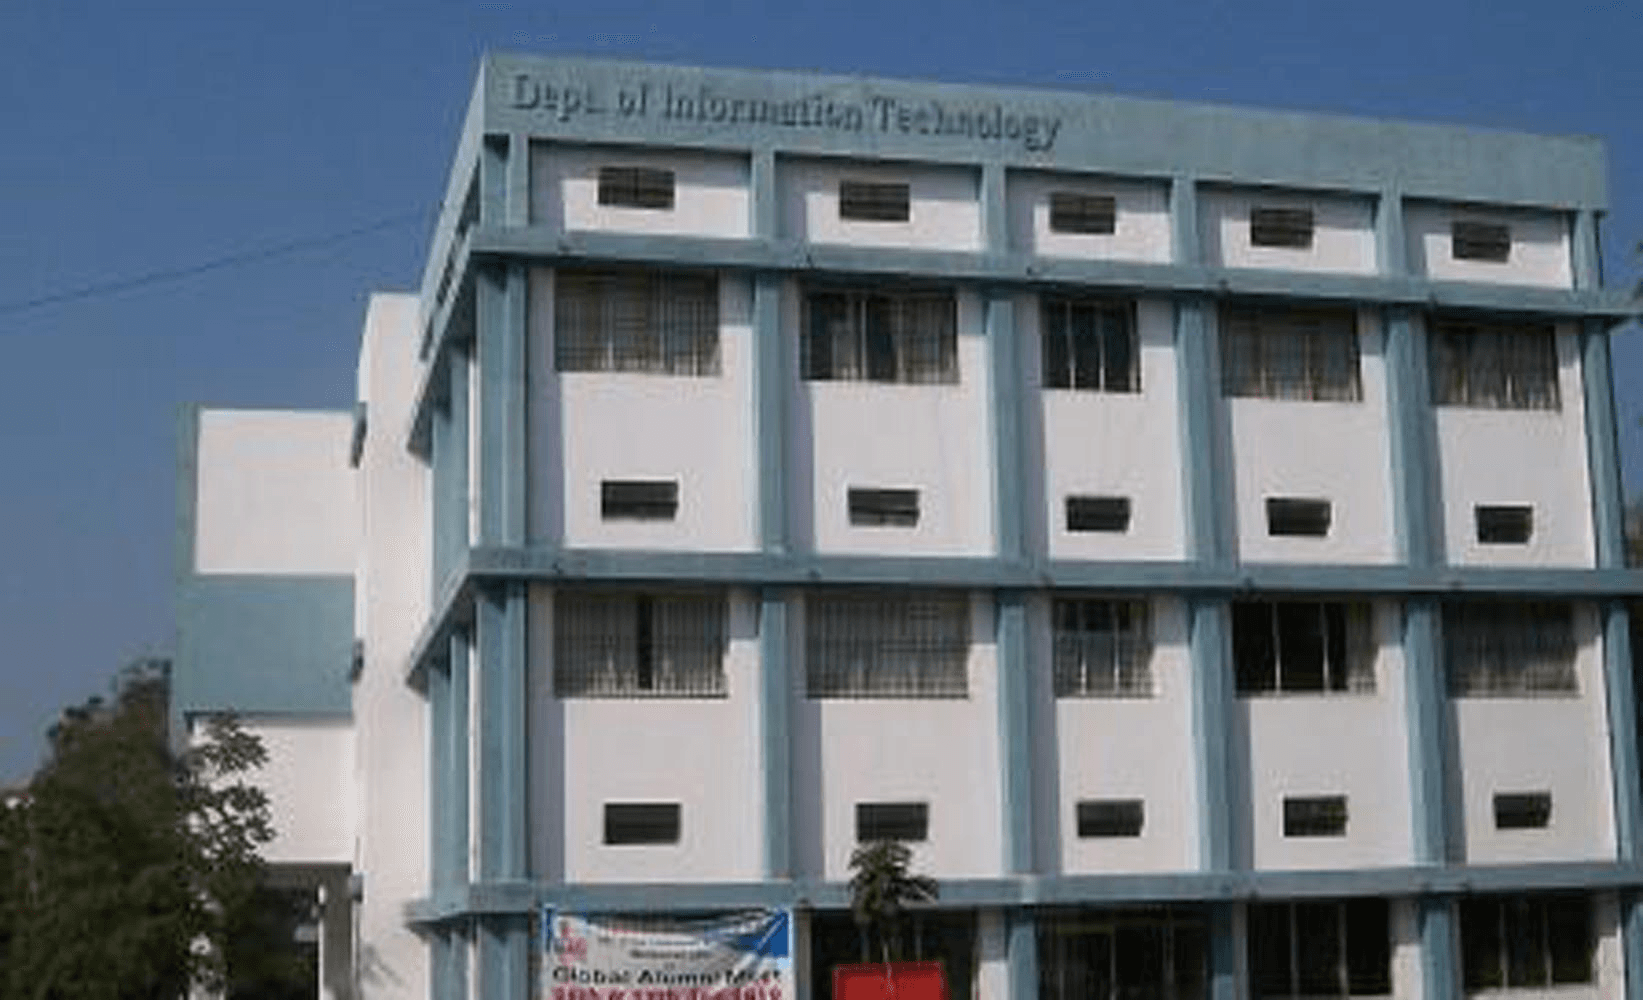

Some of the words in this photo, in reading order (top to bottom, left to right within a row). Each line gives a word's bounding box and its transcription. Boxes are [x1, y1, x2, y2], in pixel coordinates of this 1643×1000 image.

[617, 82, 650, 117] of
[665, 82, 863, 133] Information
[870, 96, 1062, 152] Technology
[552, 966, 631, 985] Global
[636, 968, 722, 985] Alumni
